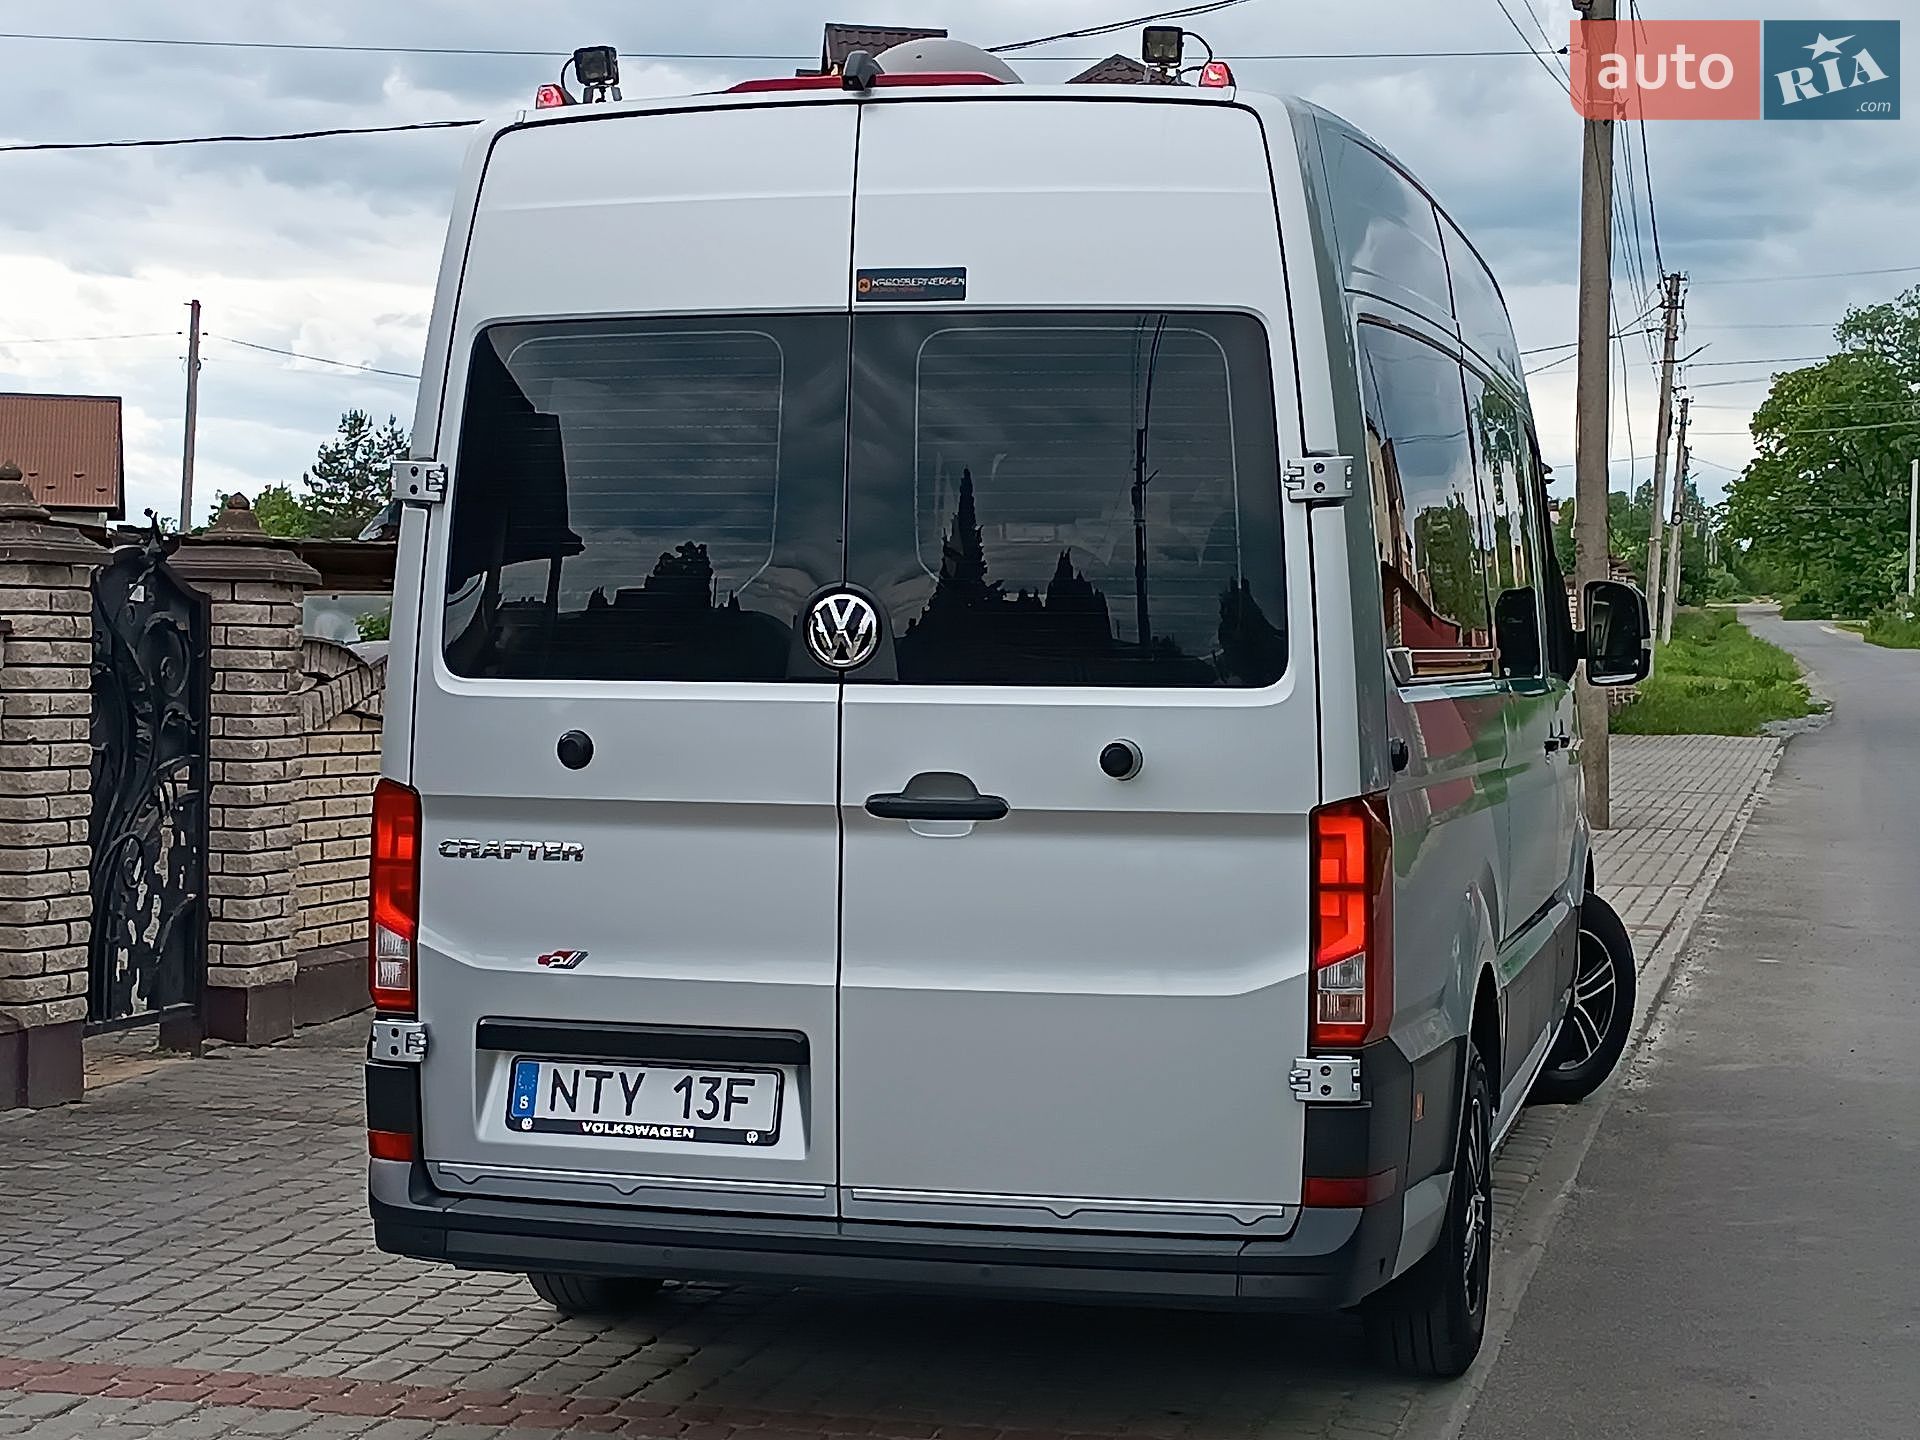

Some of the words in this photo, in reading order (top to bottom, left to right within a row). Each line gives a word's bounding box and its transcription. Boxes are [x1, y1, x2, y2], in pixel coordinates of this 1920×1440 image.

[438, 838, 585, 862] CRAFTER
[549, 1068, 646, 1116] NTY
[672, 1075, 756, 1122] 13F
[581, 1121, 695, 1139] VOLKSWAGEN
